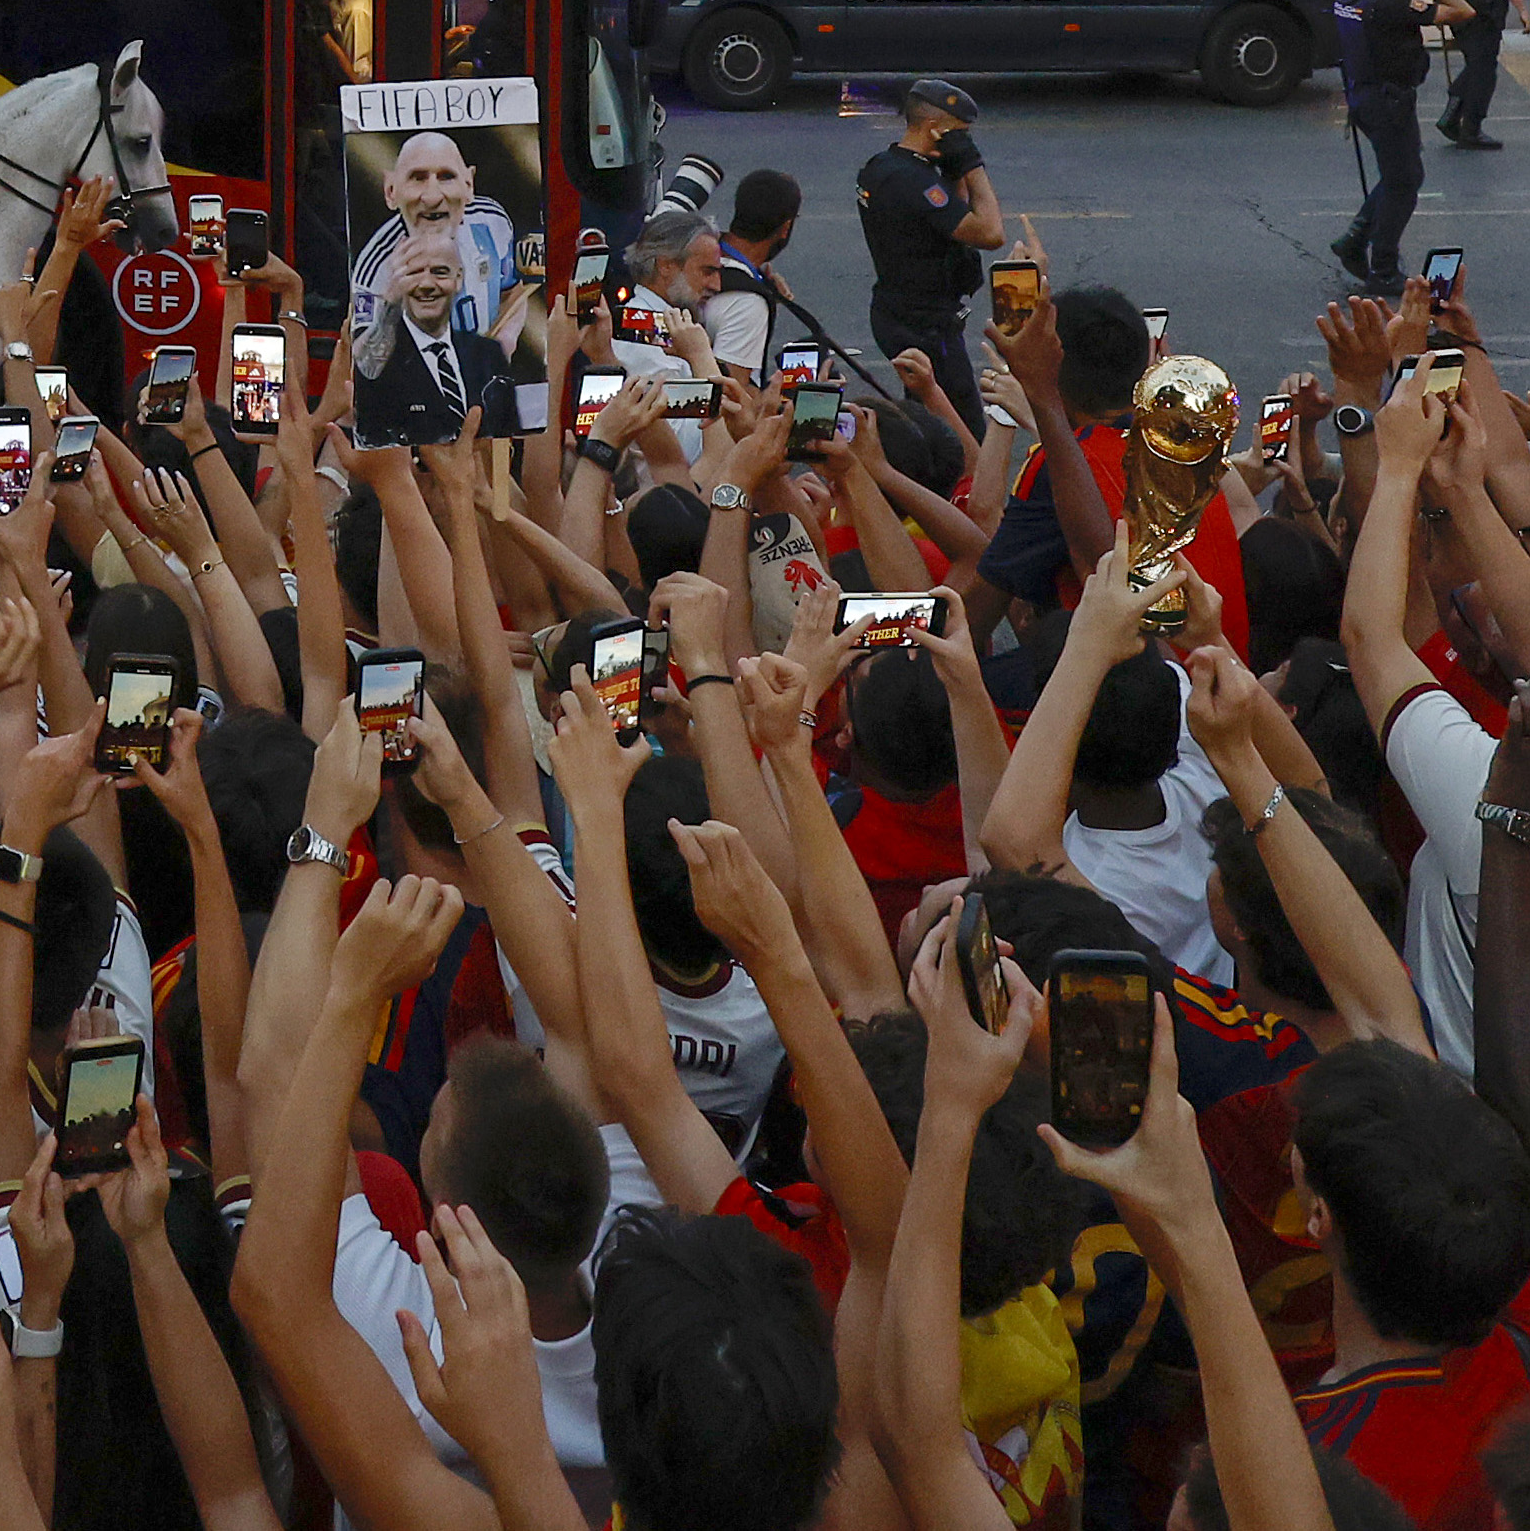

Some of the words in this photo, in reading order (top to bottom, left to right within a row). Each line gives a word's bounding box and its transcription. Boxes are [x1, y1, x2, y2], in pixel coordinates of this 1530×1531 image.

[357, 87, 439, 127] FIFA
[445, 84, 506, 123] BOY
[134, 269, 180, 289] RF
[134, 293, 180, 314] EF
